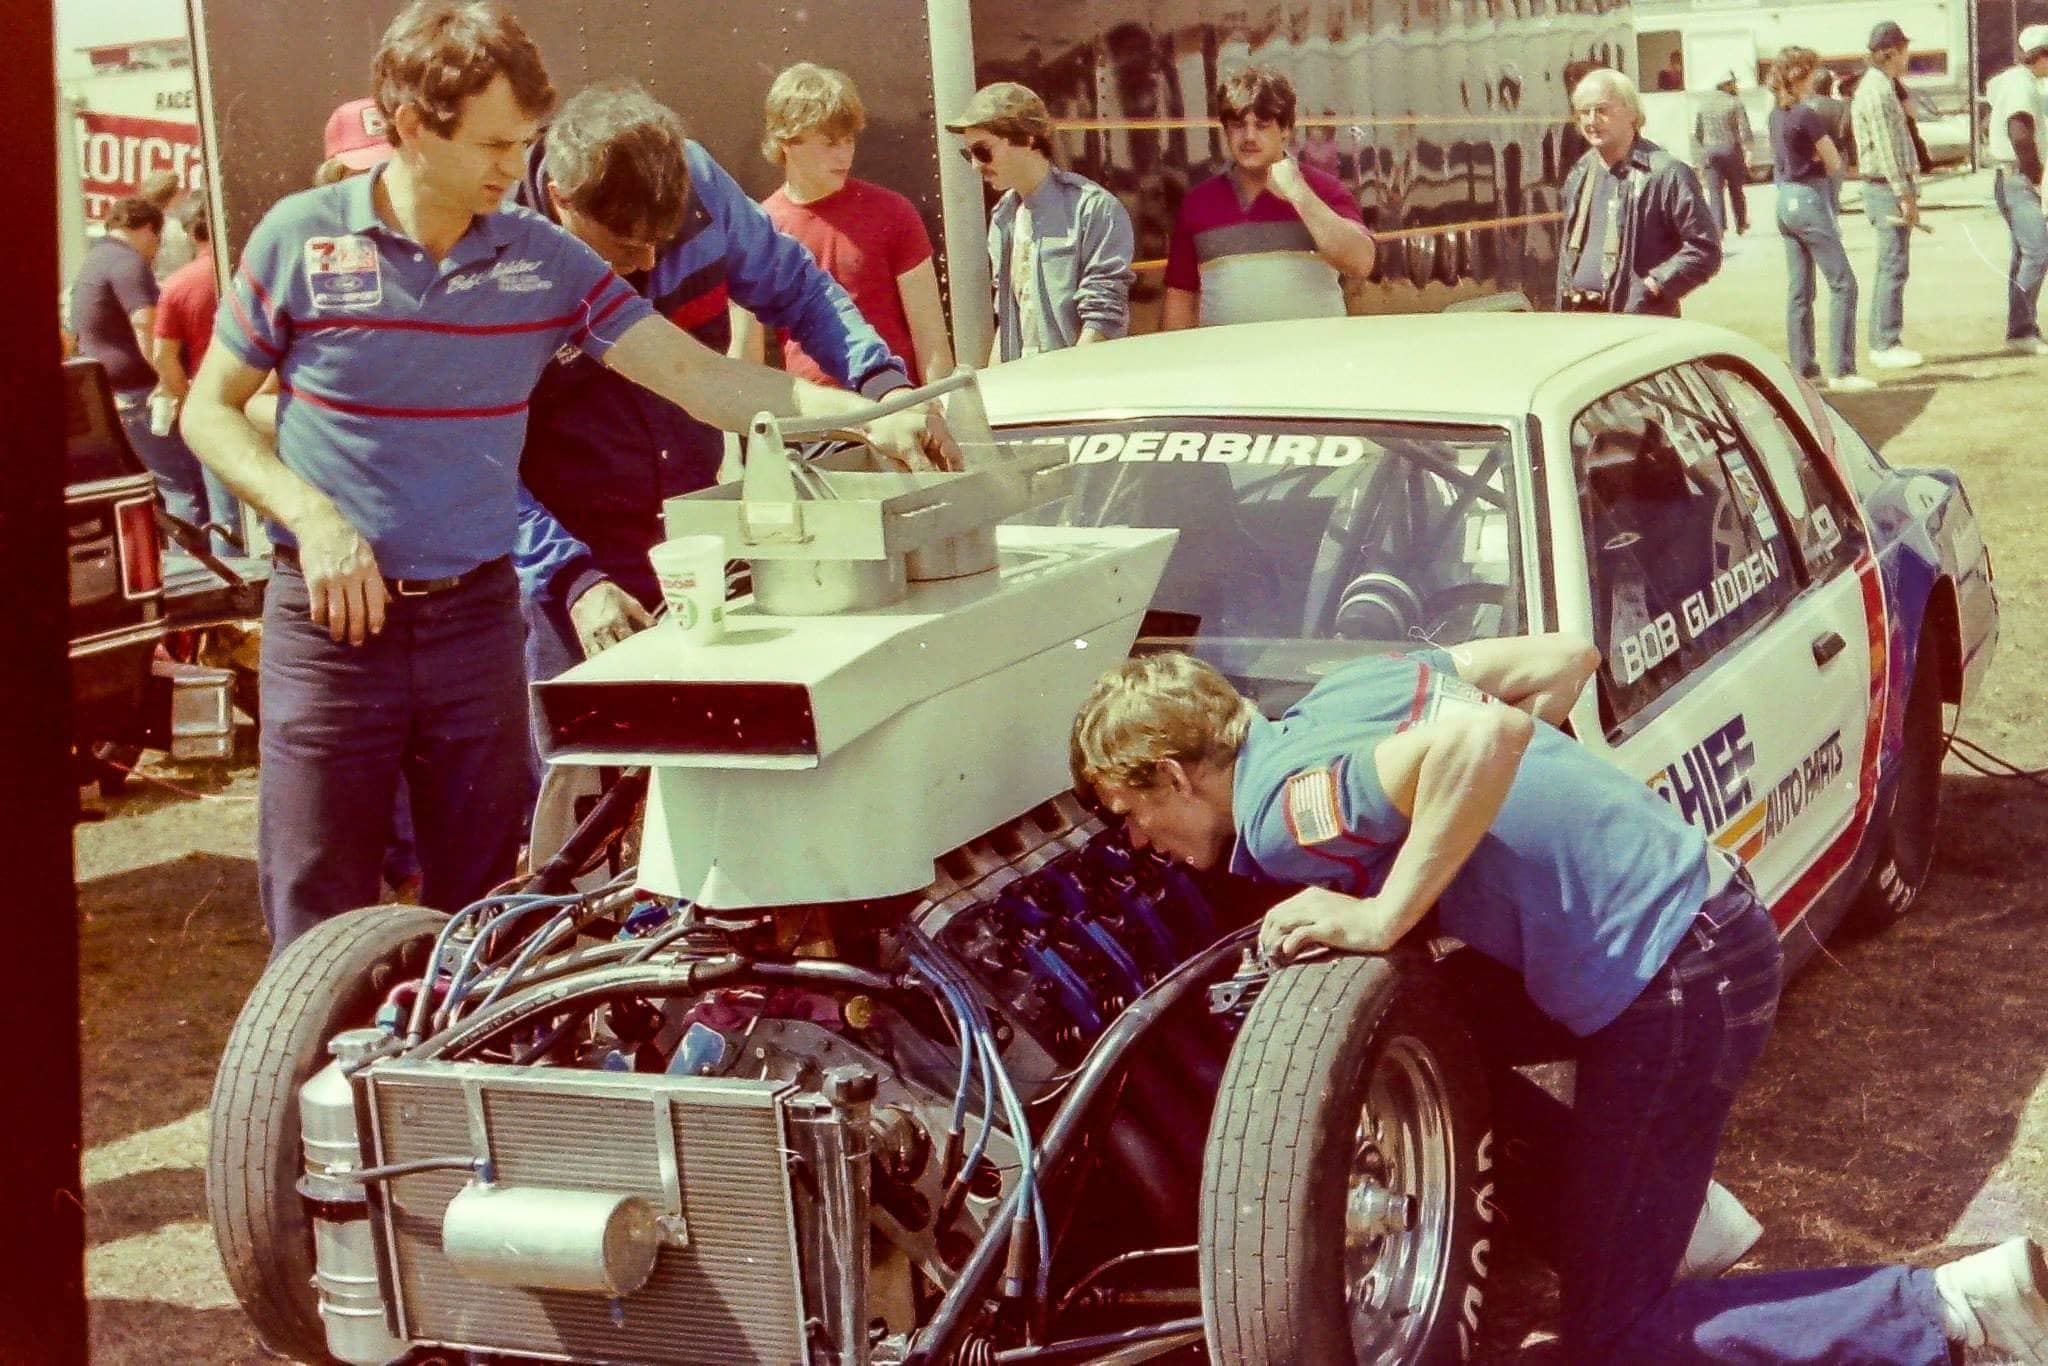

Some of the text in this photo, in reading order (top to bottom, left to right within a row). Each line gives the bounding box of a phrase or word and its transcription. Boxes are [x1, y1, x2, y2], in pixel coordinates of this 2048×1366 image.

[997, 431, 1364, 467] DERBIRD
[1620, 542, 1779, 684] BOB GLIDDEN
[1658, 713, 1755, 836] HIEF
[1763, 767, 1802, 846] AUTO
